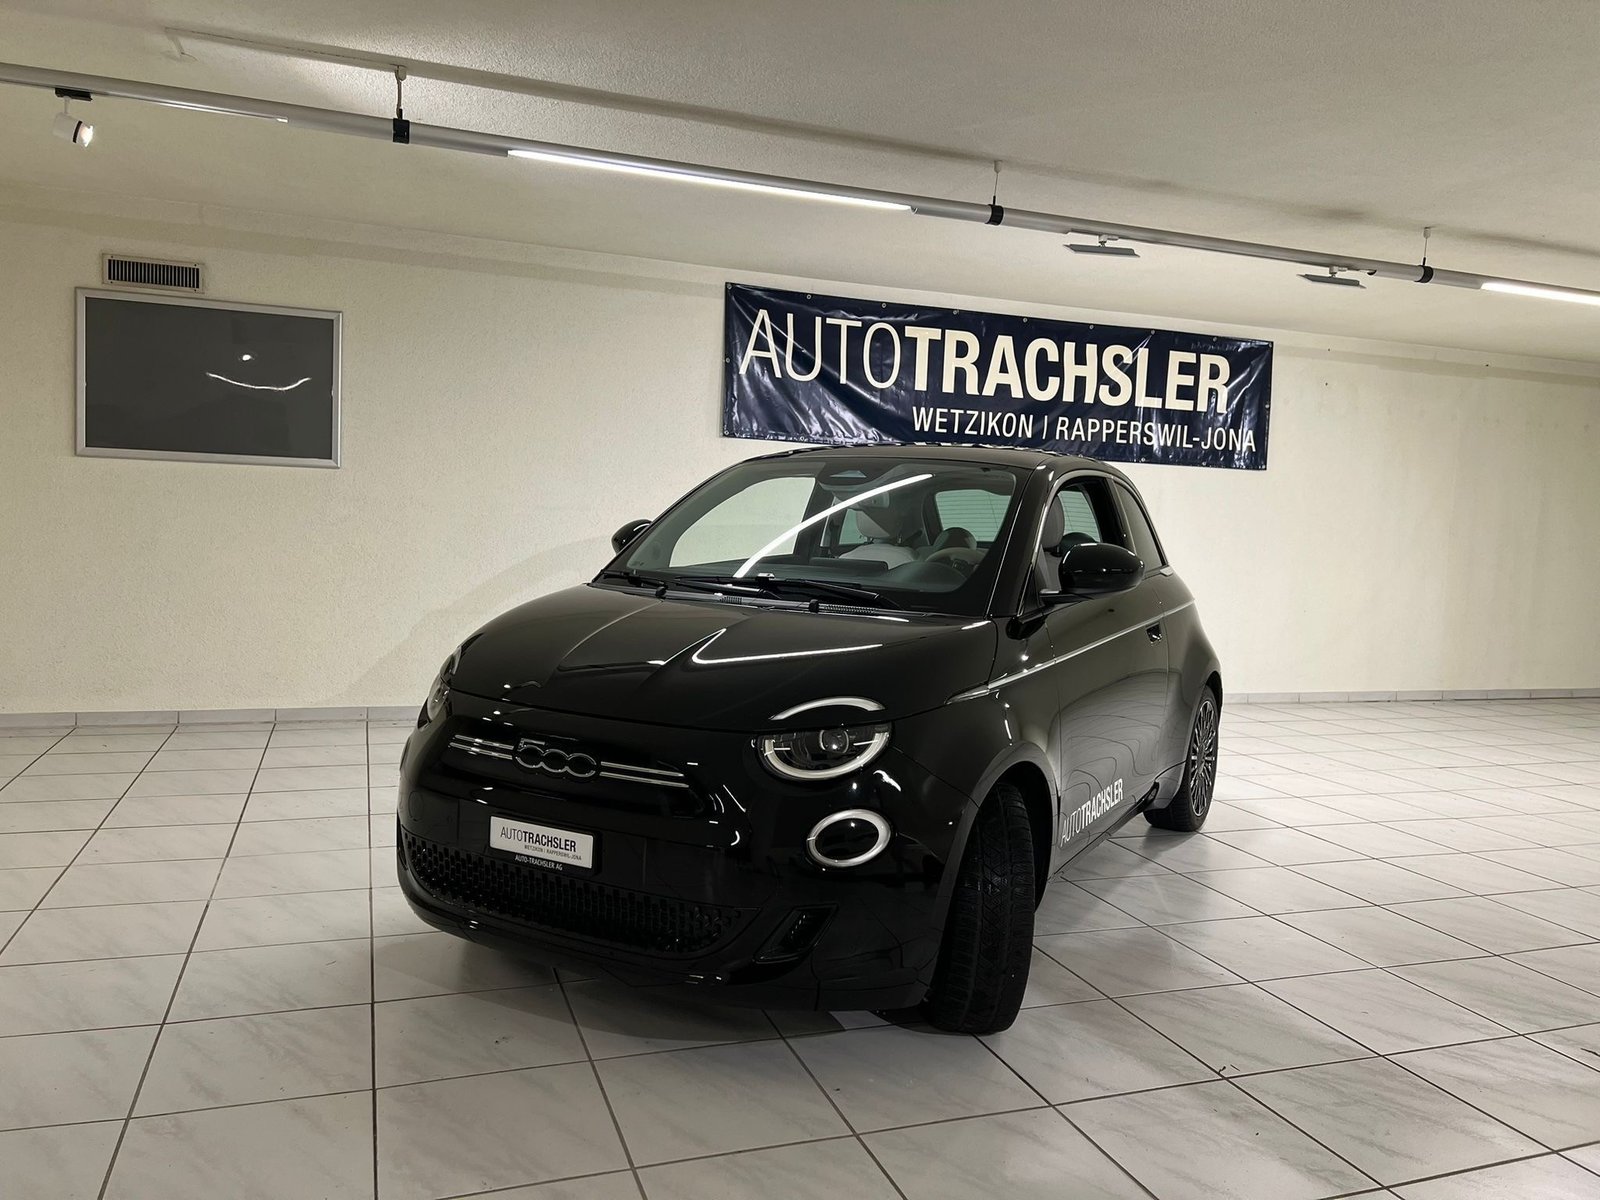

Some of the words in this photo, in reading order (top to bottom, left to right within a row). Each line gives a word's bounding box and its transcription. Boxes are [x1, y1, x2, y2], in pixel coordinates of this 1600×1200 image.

[739, 308, 1232, 414] AUTOTRACHSLER
[912, 406, 1034, 439] WETZIKON
[1055, 418, 1257, 452] RAPPERSWIL-JONA
[515, 737, 597, 778] 500
[1060, 778, 1124, 848] AUTOTRACHSLER
[500, 826, 577, 852] AUTOTRACHSLER
[514, 854, 555, 870] AUTO-TRACHSLER
[555, 863, 563, 871] AG
